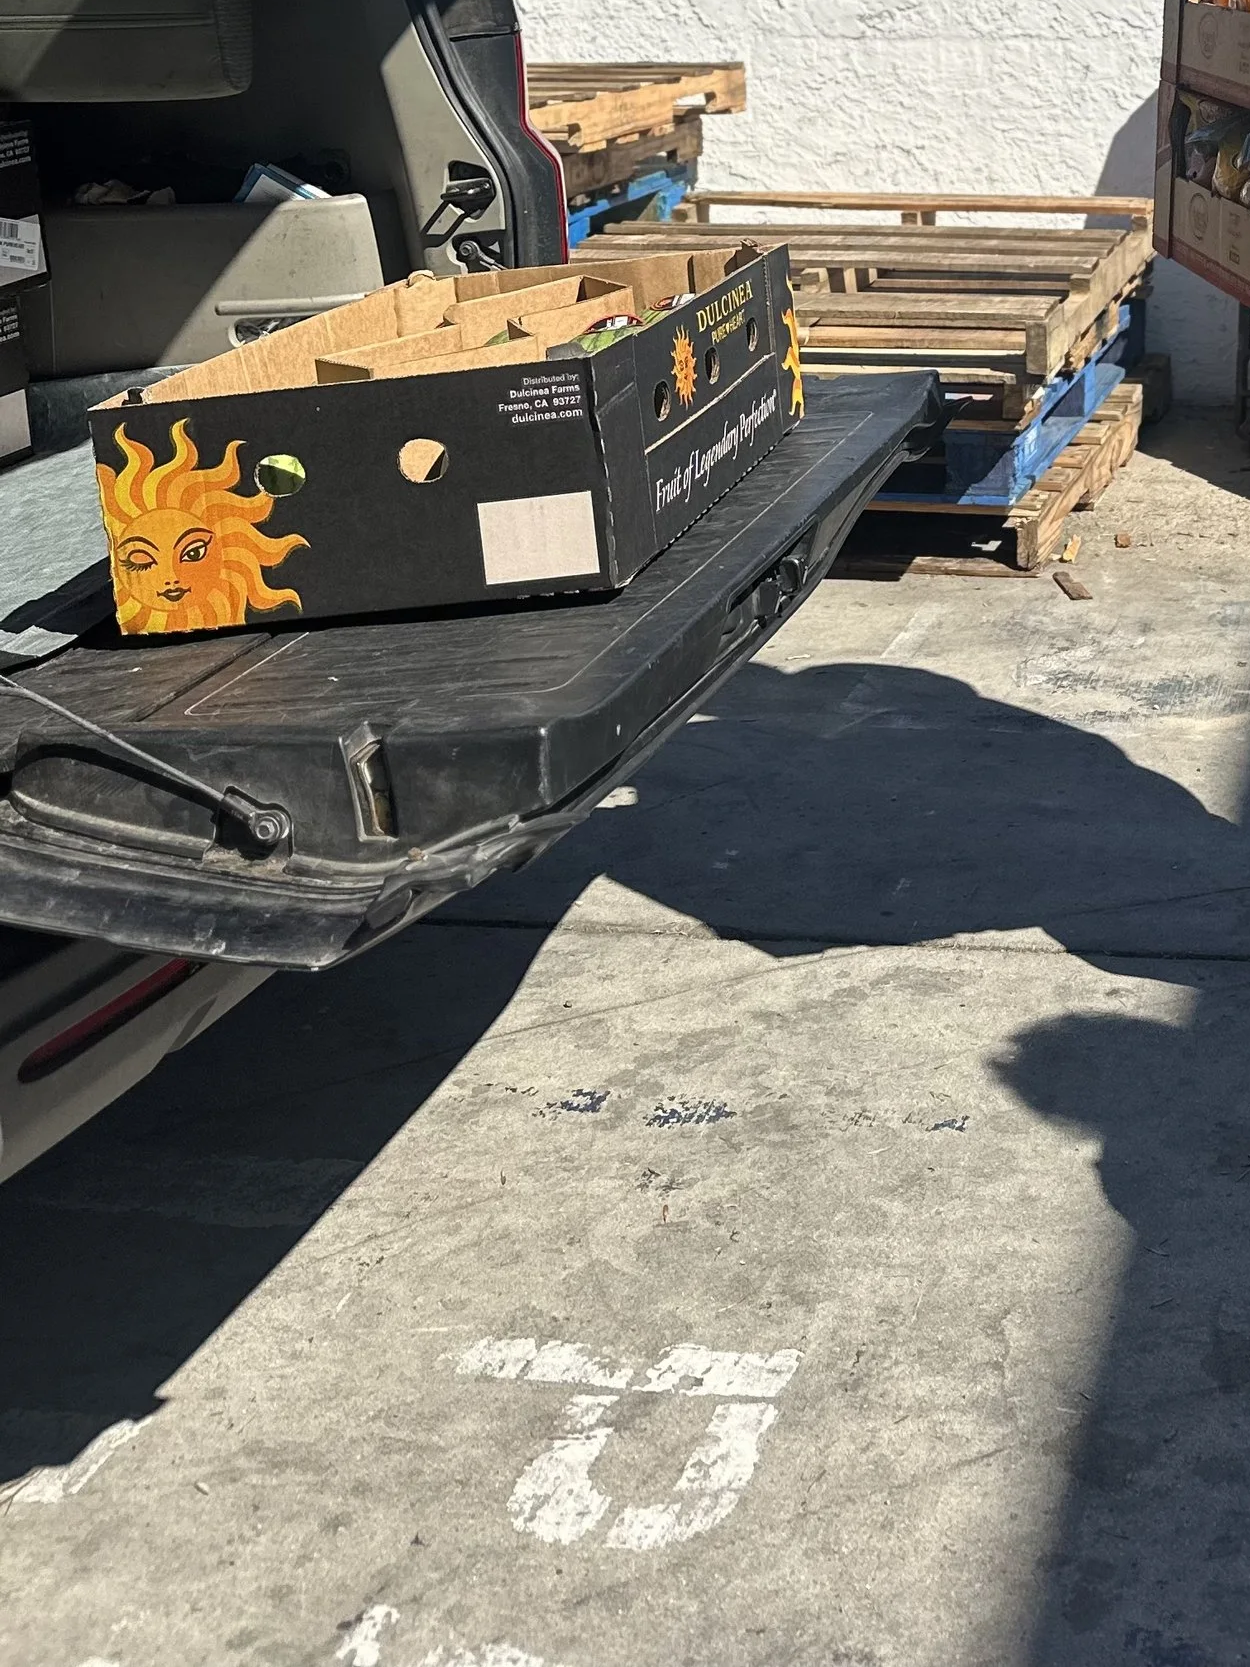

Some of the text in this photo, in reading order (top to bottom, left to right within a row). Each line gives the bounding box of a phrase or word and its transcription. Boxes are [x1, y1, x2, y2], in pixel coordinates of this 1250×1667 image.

[695, 279, 753, 333] DULCINEA
[523, 373, 580, 386] Distributed by:
[509, 384, 580, 399] Dulcinea Farms
[498, 395, 581, 412] Fresno, CA 93727
[511, 408, 583, 424] dulcinea.com
[655, 466, 682, 512] Fruit
[683, 450, 695, 503] of
[694, 420, 740, 487] Legendary
